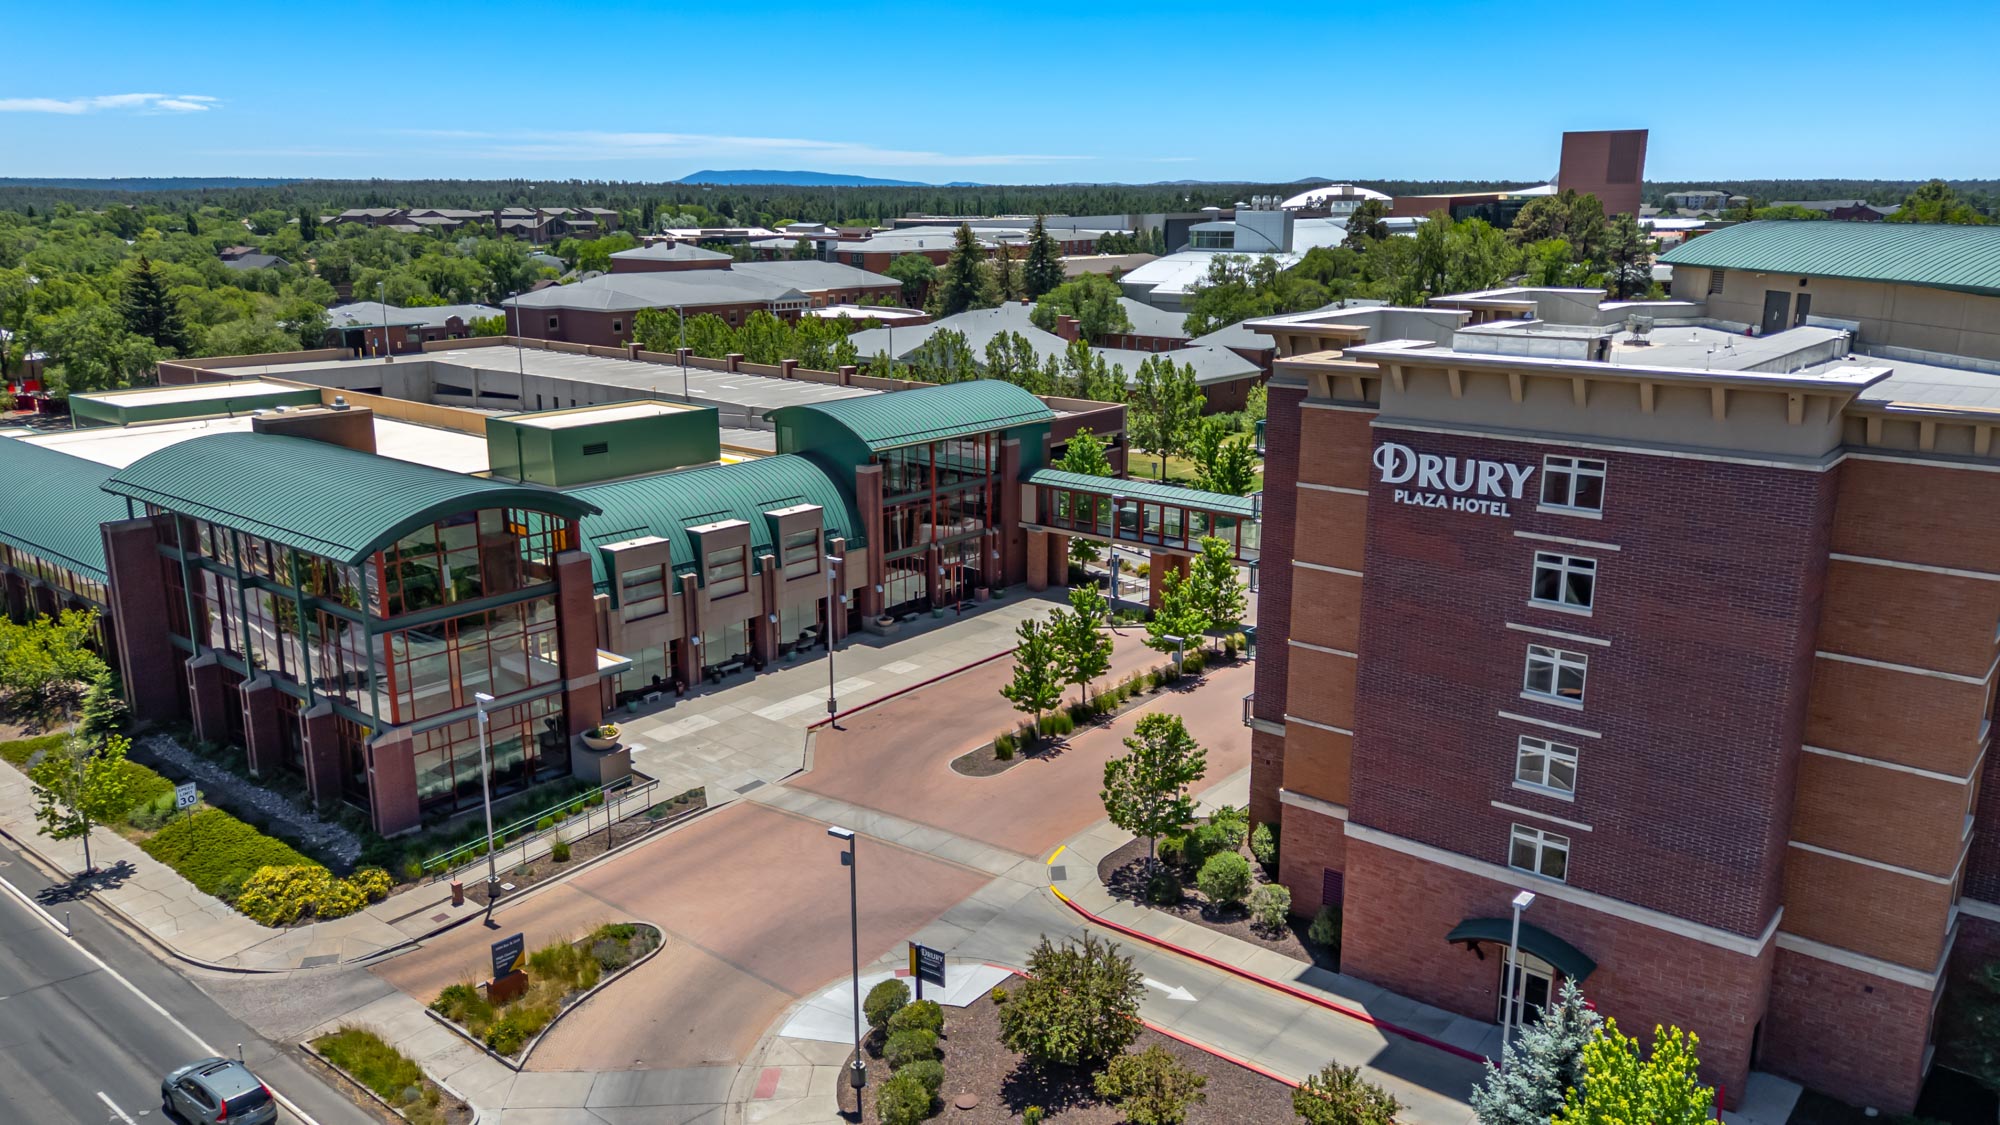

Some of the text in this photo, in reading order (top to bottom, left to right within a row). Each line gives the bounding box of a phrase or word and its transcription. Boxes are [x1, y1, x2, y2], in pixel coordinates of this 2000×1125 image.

[1373, 442, 1536, 499] DRURY
[1394, 489, 1511, 517] PLAZA HOTEL
[180, 795, 195, 806] 30
